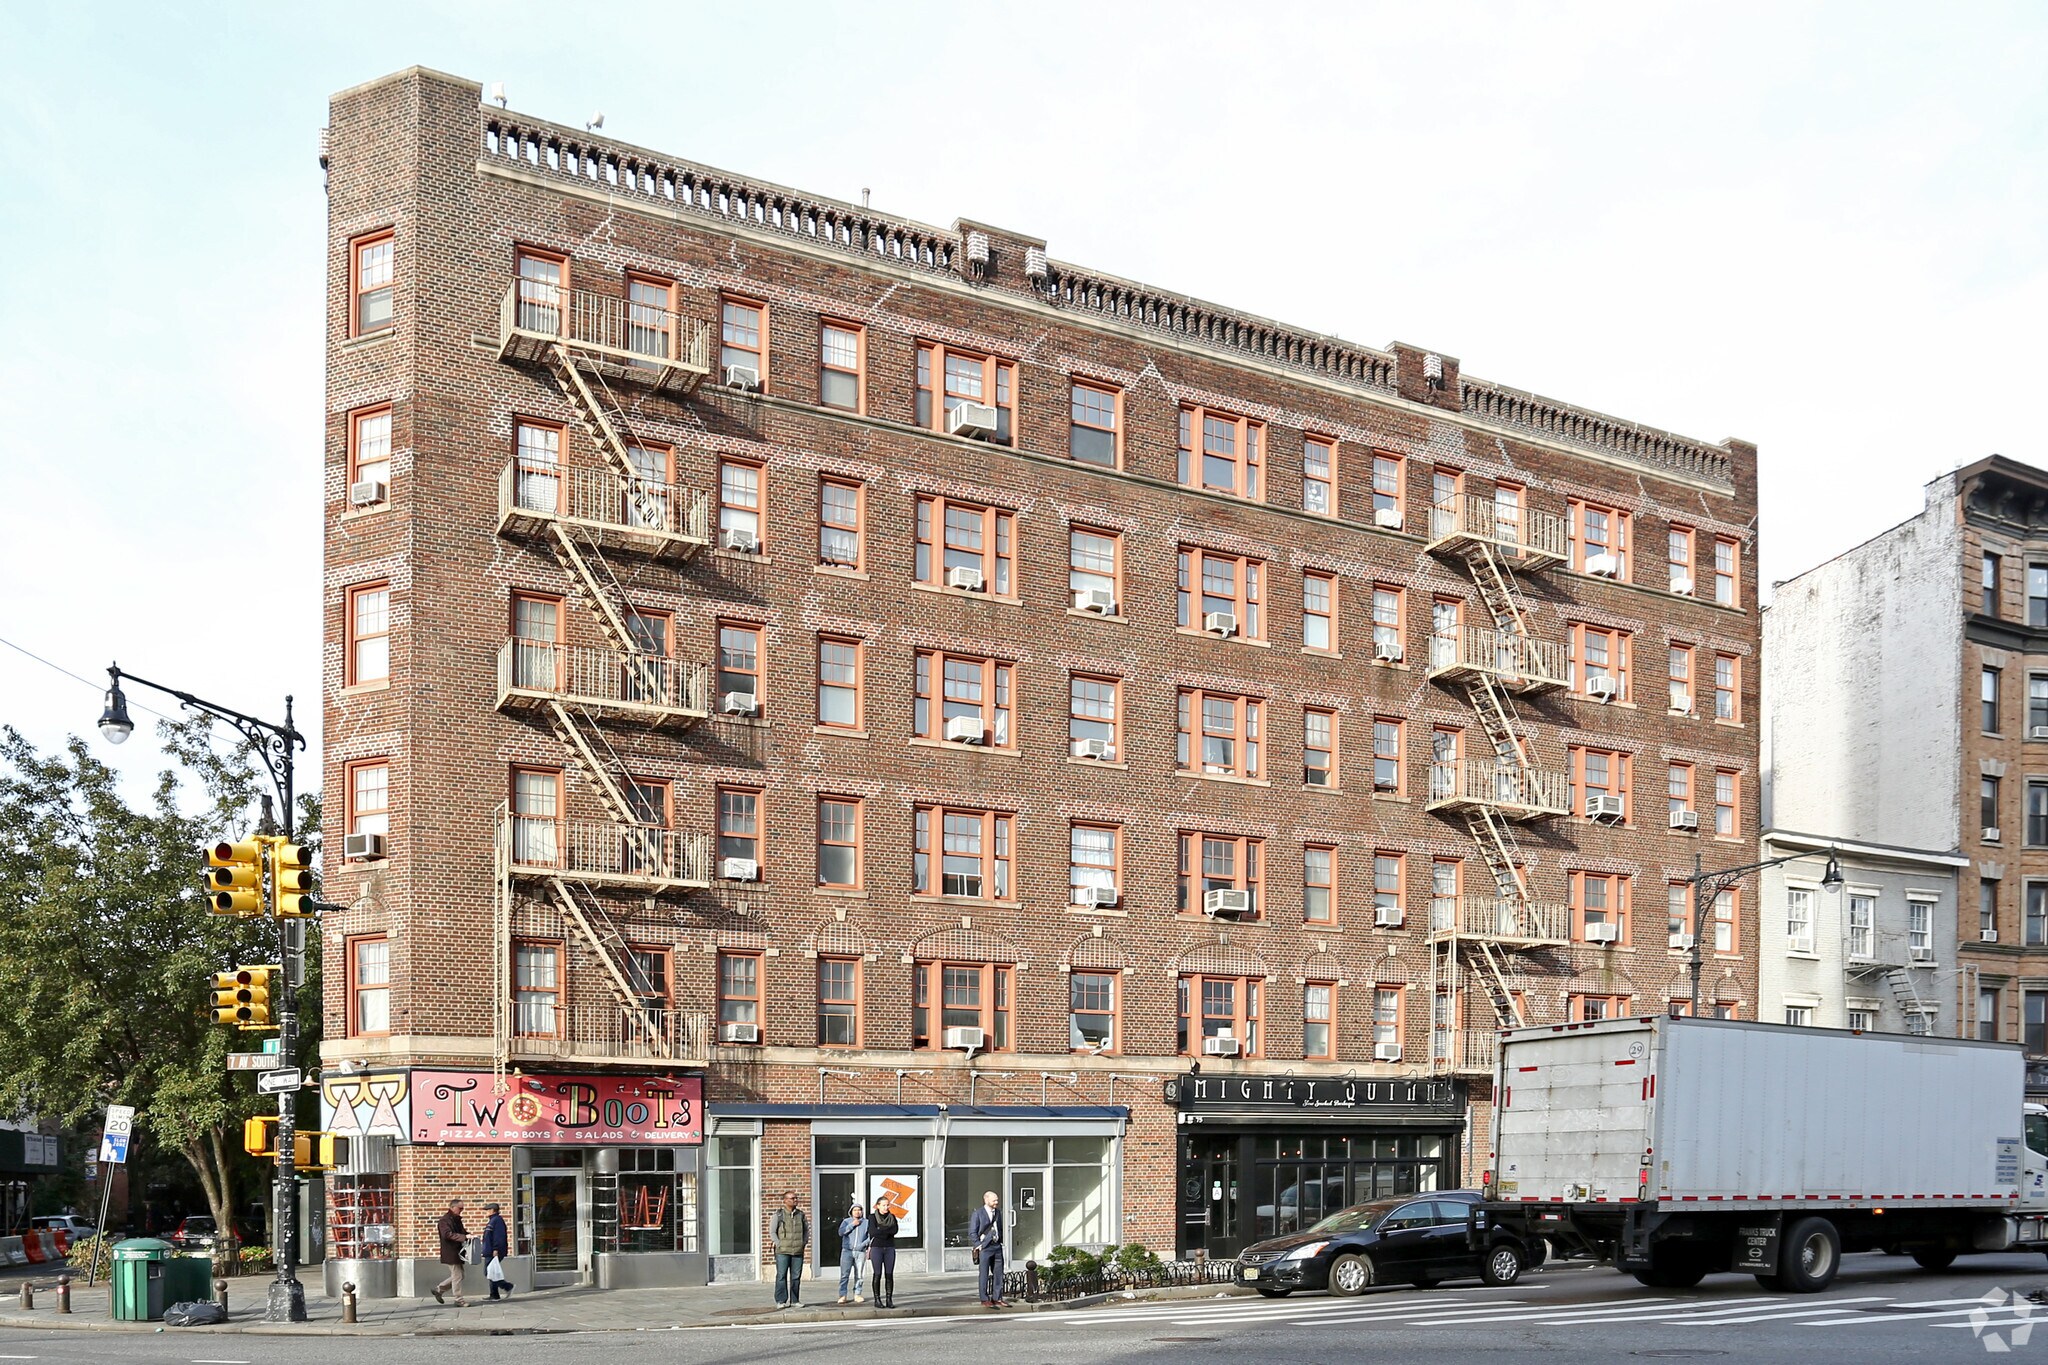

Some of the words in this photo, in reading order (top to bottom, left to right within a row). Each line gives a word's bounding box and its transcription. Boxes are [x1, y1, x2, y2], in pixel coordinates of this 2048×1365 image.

[1631, 1045, 1643, 1055] 29
[229, 1056, 236, 1068] 7
[239, 1056, 249, 1068] AV
[251, 1055, 276, 1068] SOUTH
[263, 1077, 276, 1087] ONE
[283, 1075, 296, 1084] WAY
[1194, 1079, 1316, 1100] MIGHTY
[110, 1120, 128, 1131] 20
[440, 1130, 487, 1138] PIZZA
[521, 1131, 551, 1139] BOYS
[575, 1131, 624, 1139] SALADS
[644, 1131, 691, 1139] DELIVERY
[1759, 1228, 1776, 1237] TRUCK
[1747, 1237, 1767, 1245] CENTER
